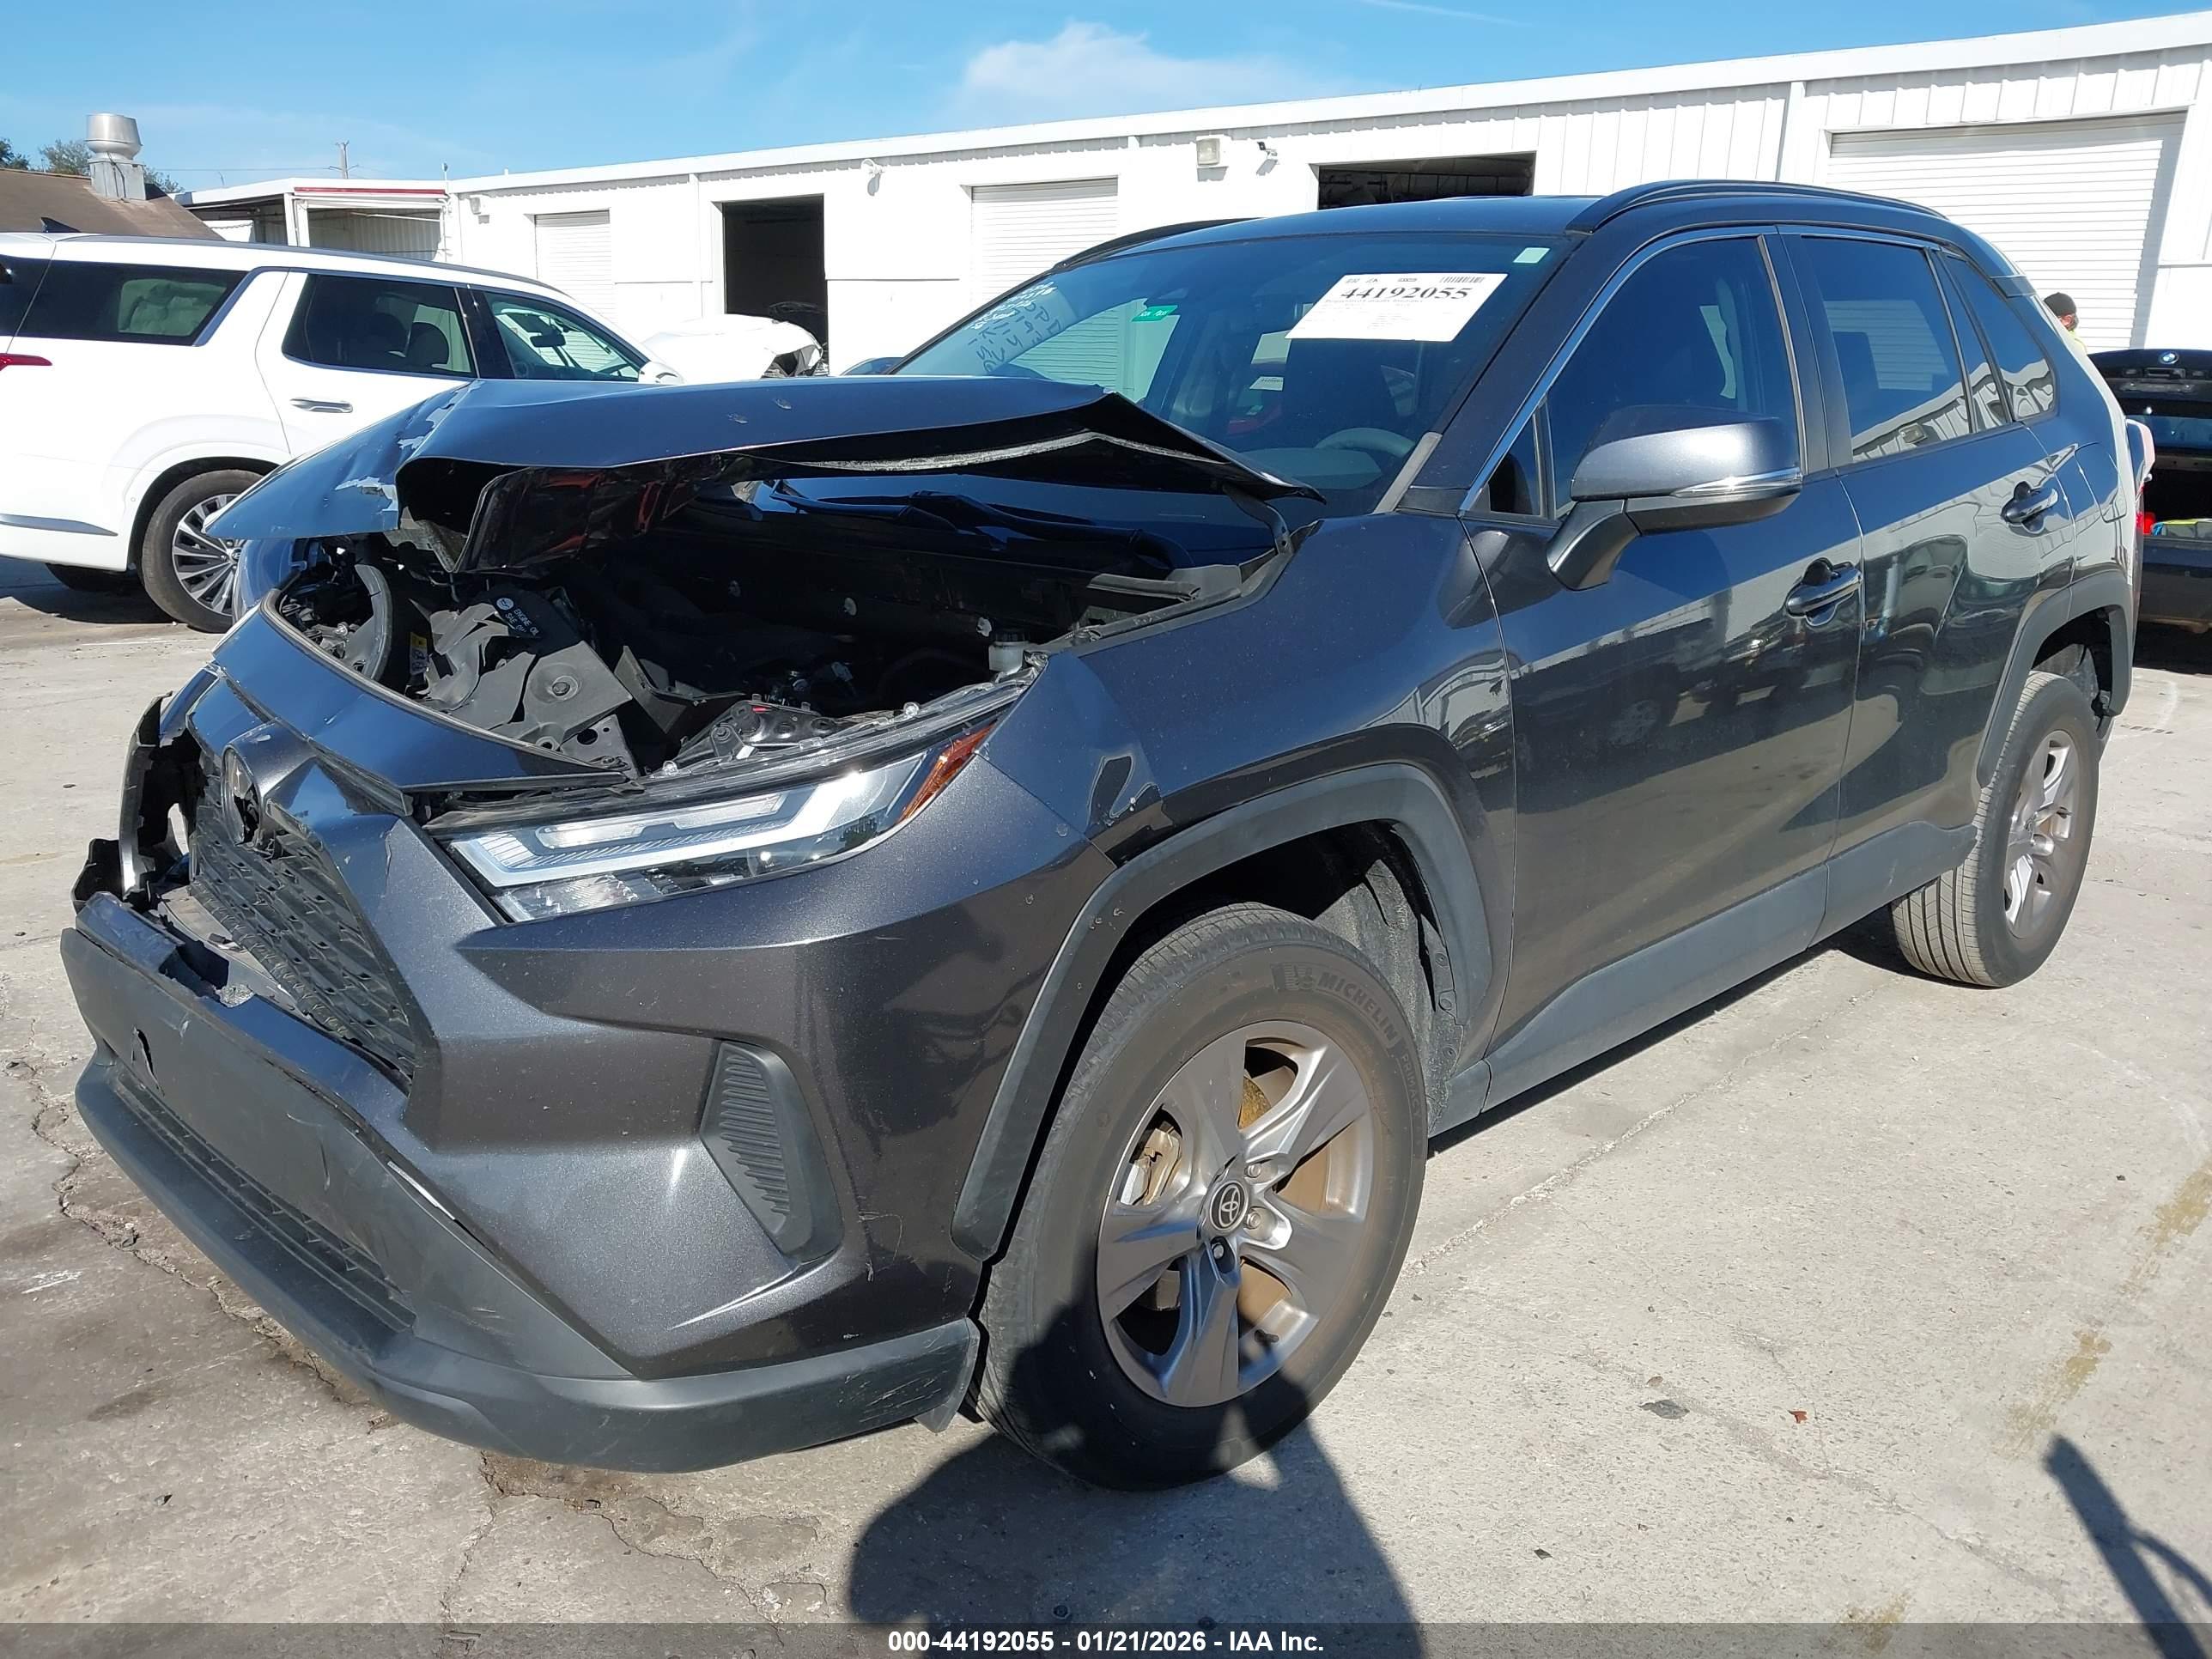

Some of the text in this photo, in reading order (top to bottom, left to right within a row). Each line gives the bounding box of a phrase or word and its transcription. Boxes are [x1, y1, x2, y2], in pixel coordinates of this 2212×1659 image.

[1340, 287, 1473, 300] 44192055
[505, 612, 518, 624] SAE
[514, 608, 532, 627] ENGINE
[1317, 971, 1400, 1048] MICHELIN
